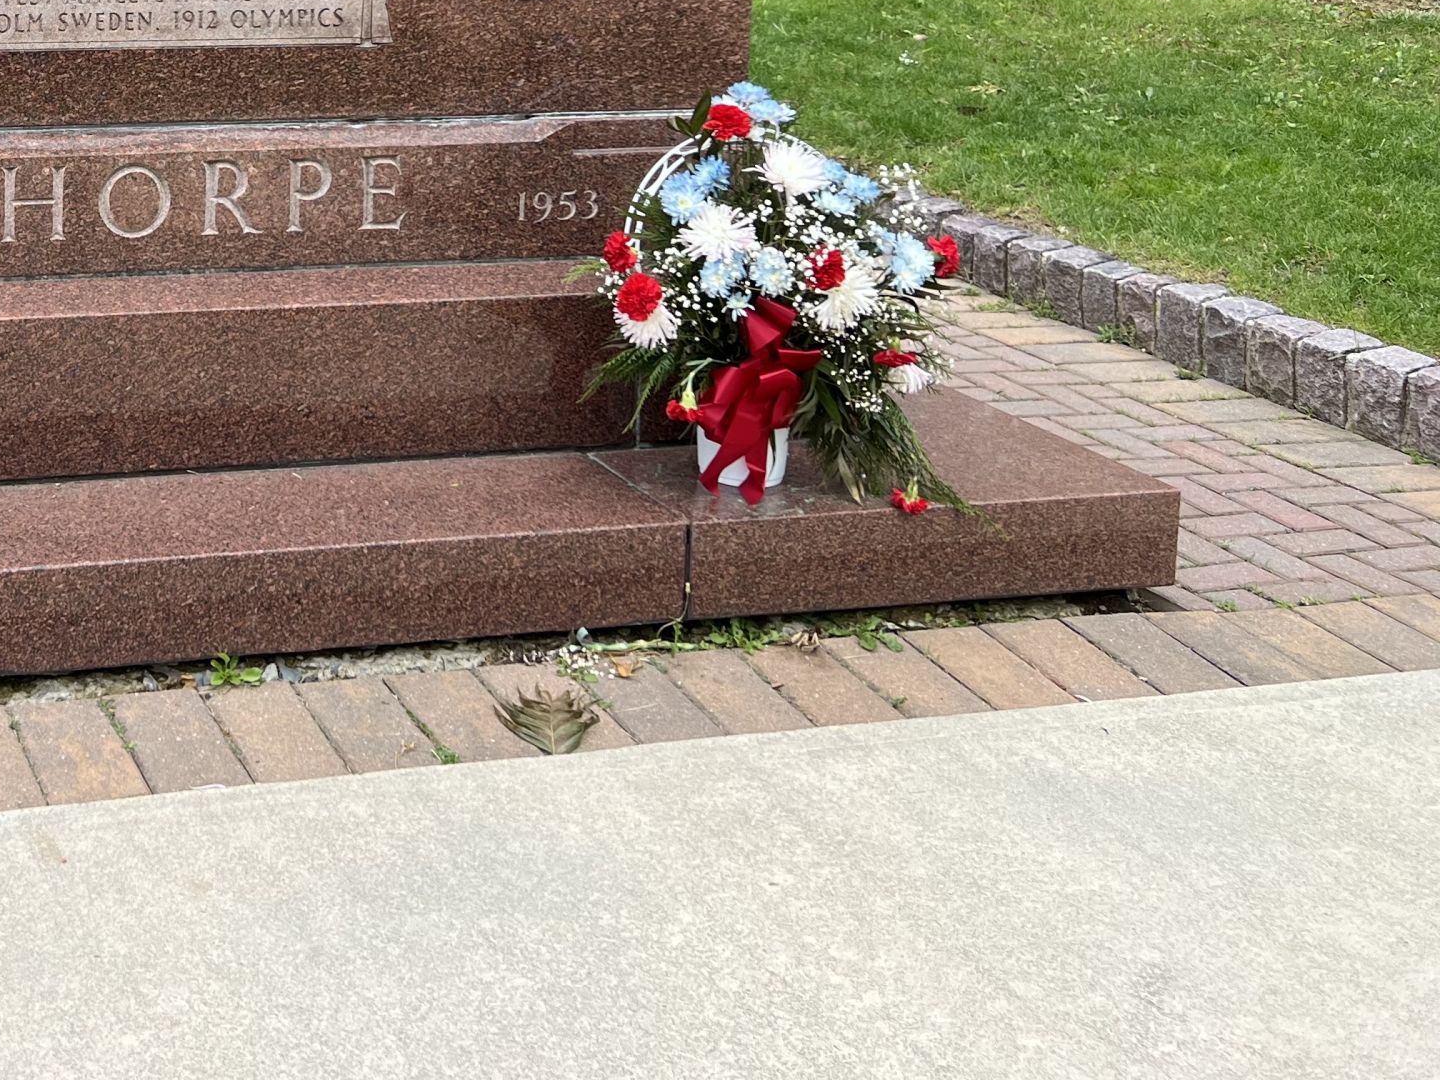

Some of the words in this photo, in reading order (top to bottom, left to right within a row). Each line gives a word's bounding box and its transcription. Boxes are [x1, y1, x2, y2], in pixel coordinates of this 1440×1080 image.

[173, 9, 218, 31] 1912
[230, 7, 344, 29] OLYMPICS
[517, 189, 600, 224] 1953
